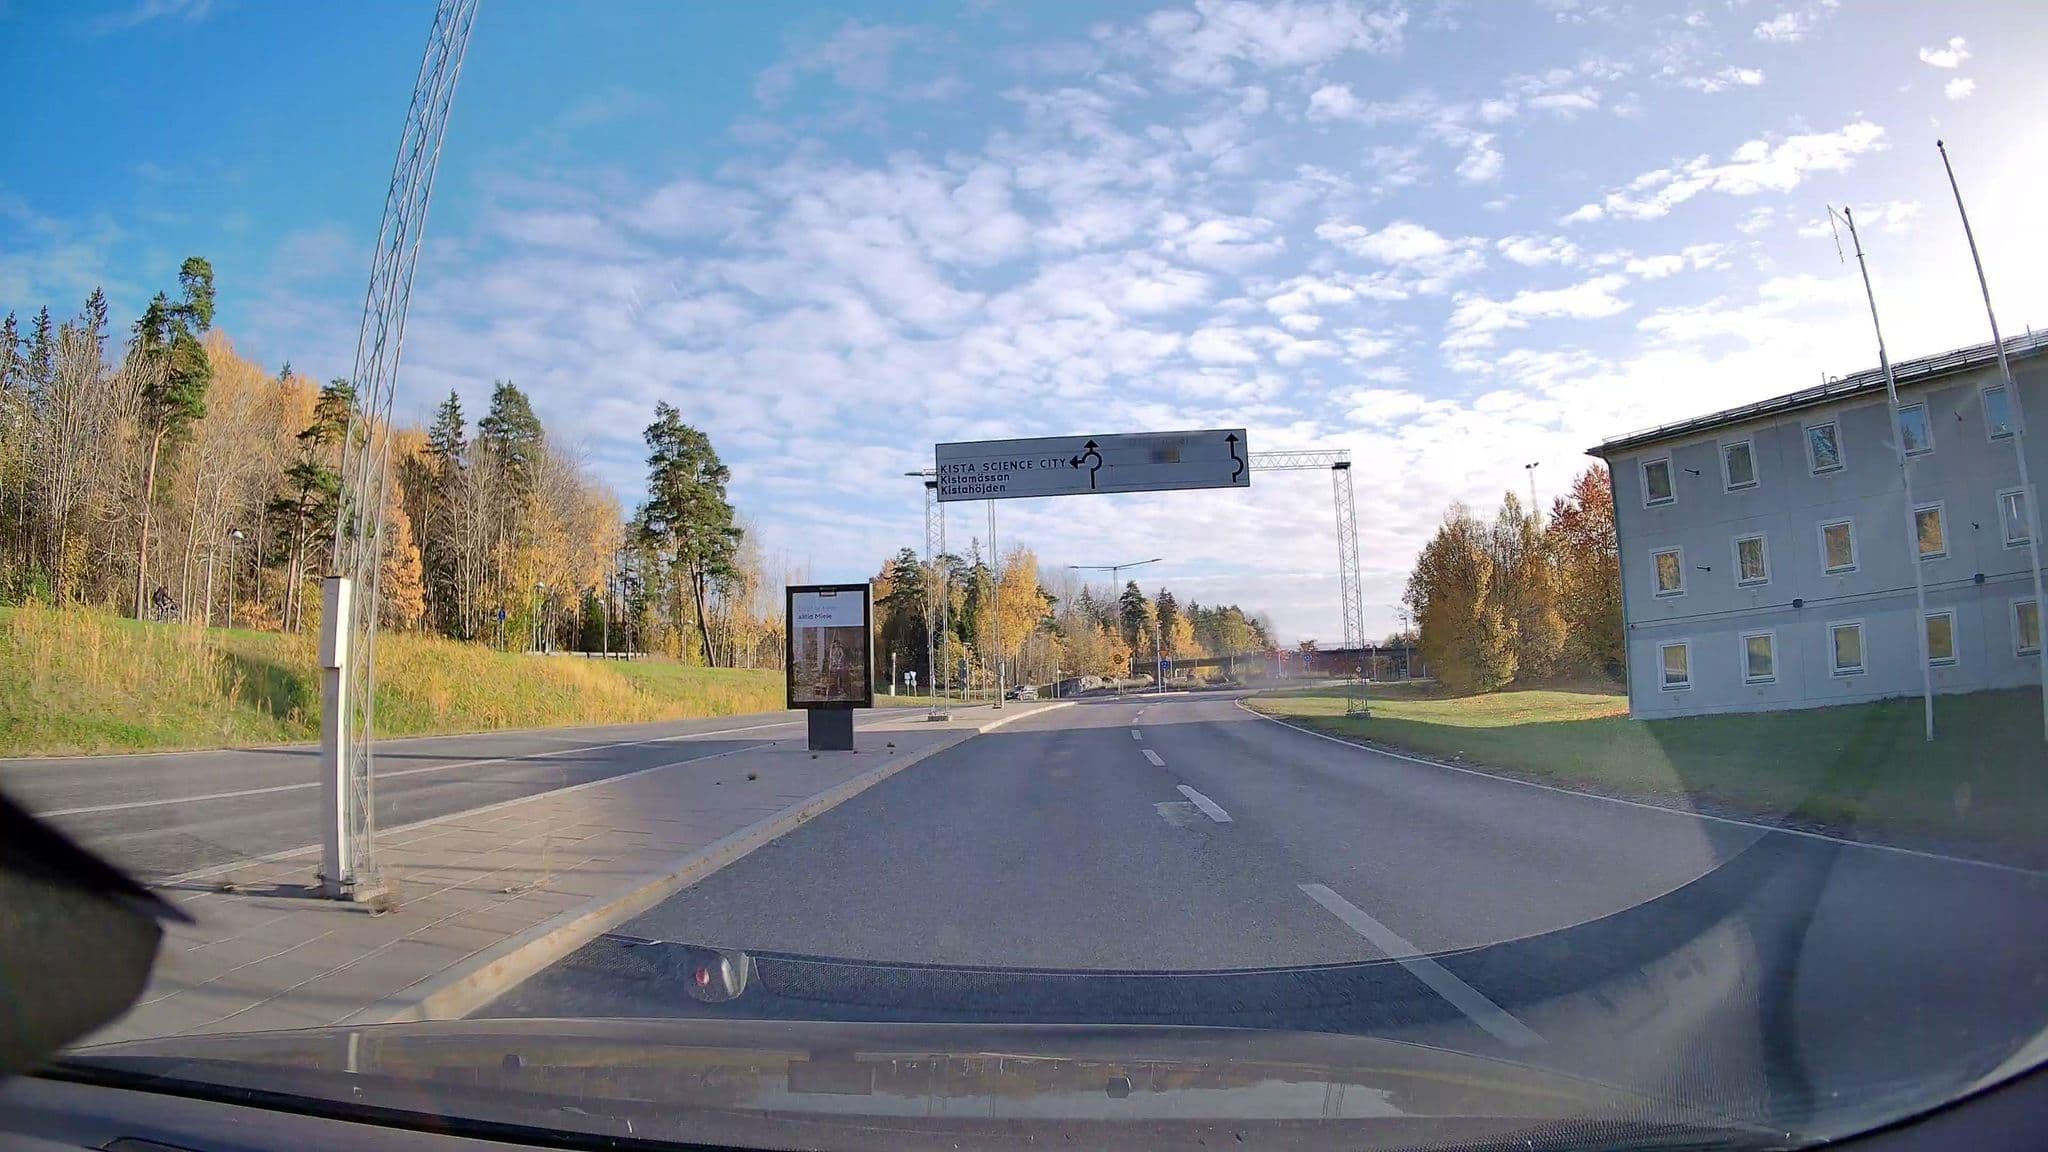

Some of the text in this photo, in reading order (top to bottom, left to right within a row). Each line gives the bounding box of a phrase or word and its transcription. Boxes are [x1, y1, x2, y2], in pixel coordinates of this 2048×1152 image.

[940, 458, 1066, 474] KISTA SCIENCE CITY
[940, 473, 1010, 485] Kistamässan
[941, 484, 1006, 496] Kistahöjden
